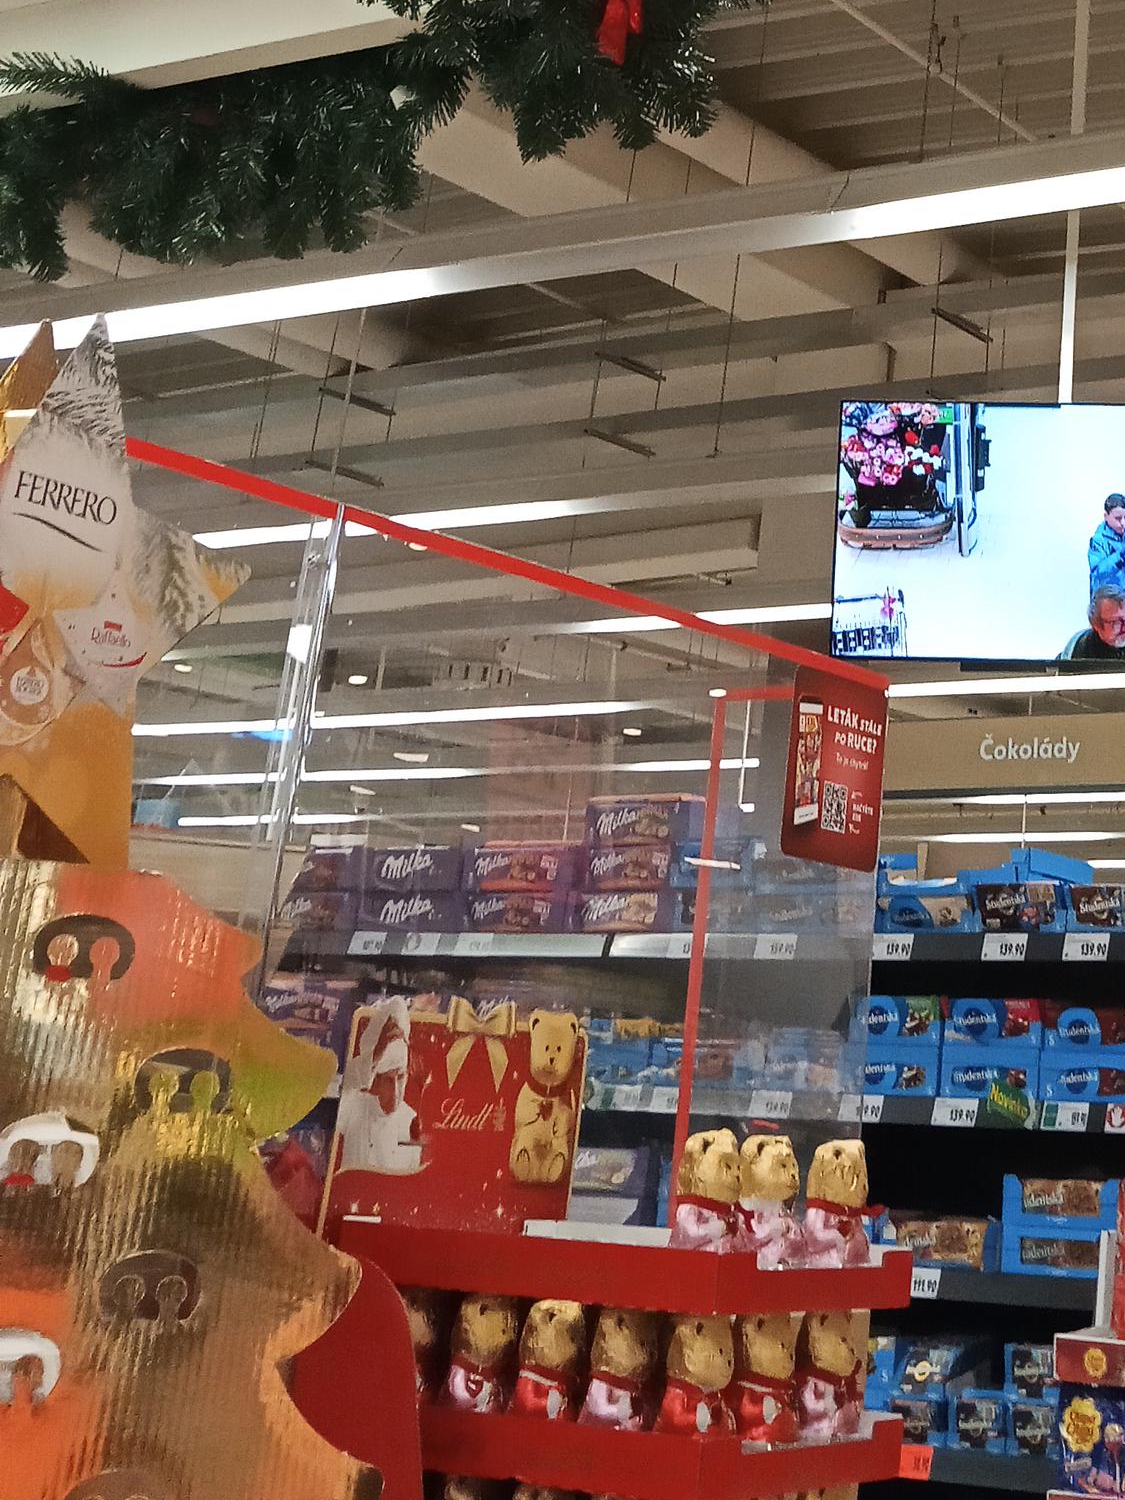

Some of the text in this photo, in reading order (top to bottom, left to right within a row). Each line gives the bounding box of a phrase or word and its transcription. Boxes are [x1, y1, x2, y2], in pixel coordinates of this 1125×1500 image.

[14, 470, 118, 526] FERRERO
[90, 626, 131, 649] Raffaello
[827, 705, 882, 737] LETÁK STÁLE
[834, 731, 877, 755] PO RUCE?
[980, 733, 1081, 764] Čokolády
[597, 808, 639, 836] Milka
[381, 850, 434, 880] Milka
[474, 853, 512, 876] Milka
[590, 851, 624, 877] Milka
[380, 894, 433, 924] Milka
[472, 897, 506, 921] Milka
[581, 894, 628, 922] Milka
[433, 1098, 495, 1131] Lindt
